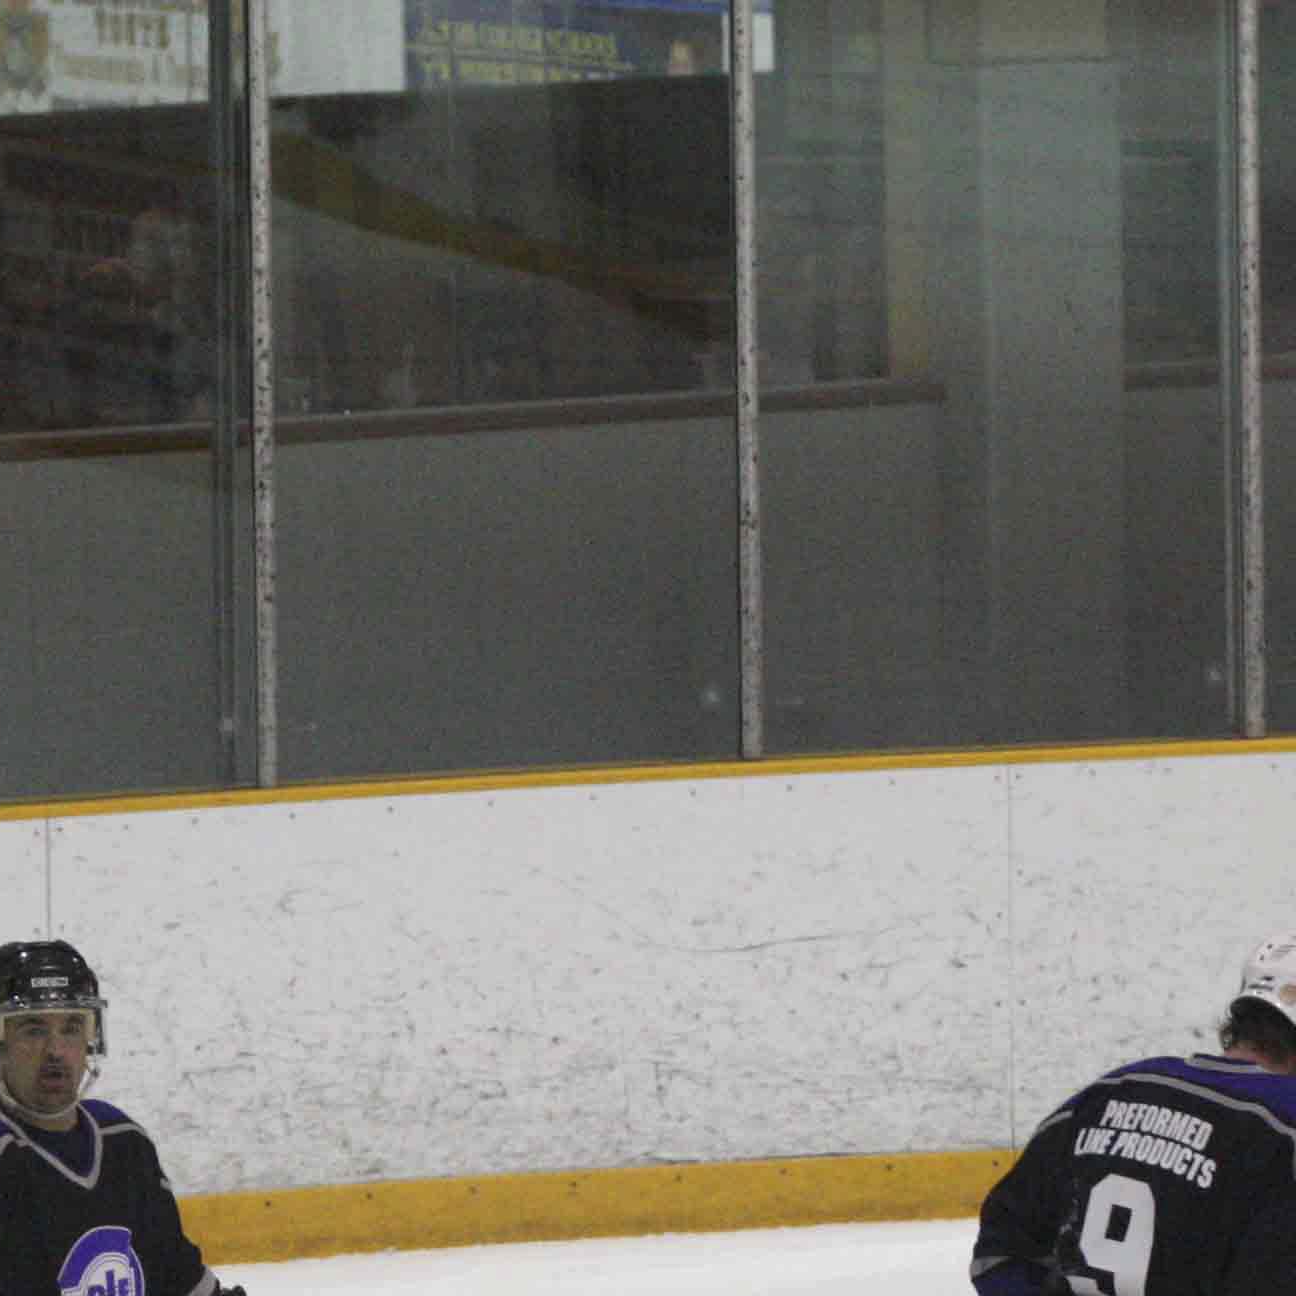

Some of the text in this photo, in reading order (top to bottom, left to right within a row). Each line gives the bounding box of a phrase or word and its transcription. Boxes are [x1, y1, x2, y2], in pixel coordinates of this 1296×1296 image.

[1099, 1099, 1214, 1151] PREFORMED
[1074, 1127, 1217, 1189] LINE PRODUCTS
